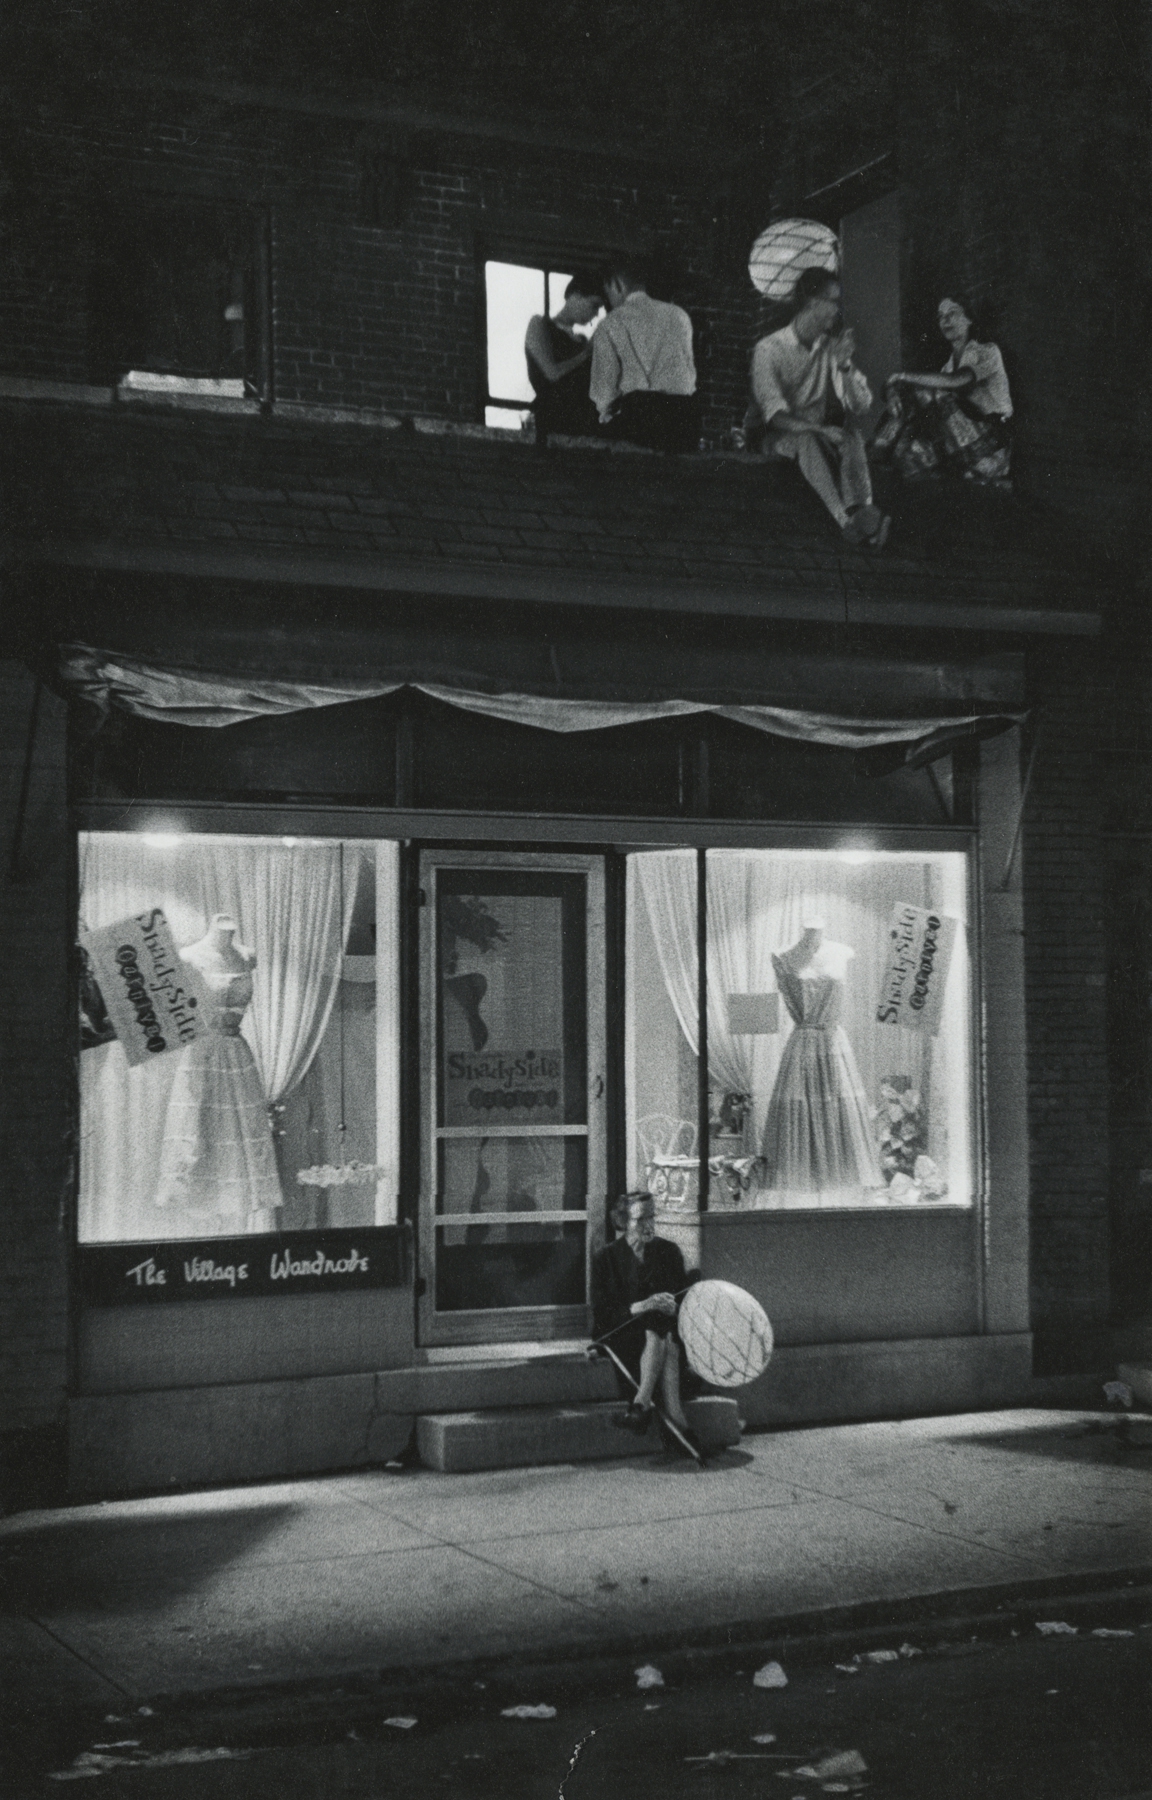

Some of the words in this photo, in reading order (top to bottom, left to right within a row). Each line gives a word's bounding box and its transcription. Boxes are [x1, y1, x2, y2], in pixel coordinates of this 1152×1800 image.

[115, 945, 166, 1053] Carnival
[126, 1257, 166, 1285] The
[184, 1256, 249, 1287] Village
